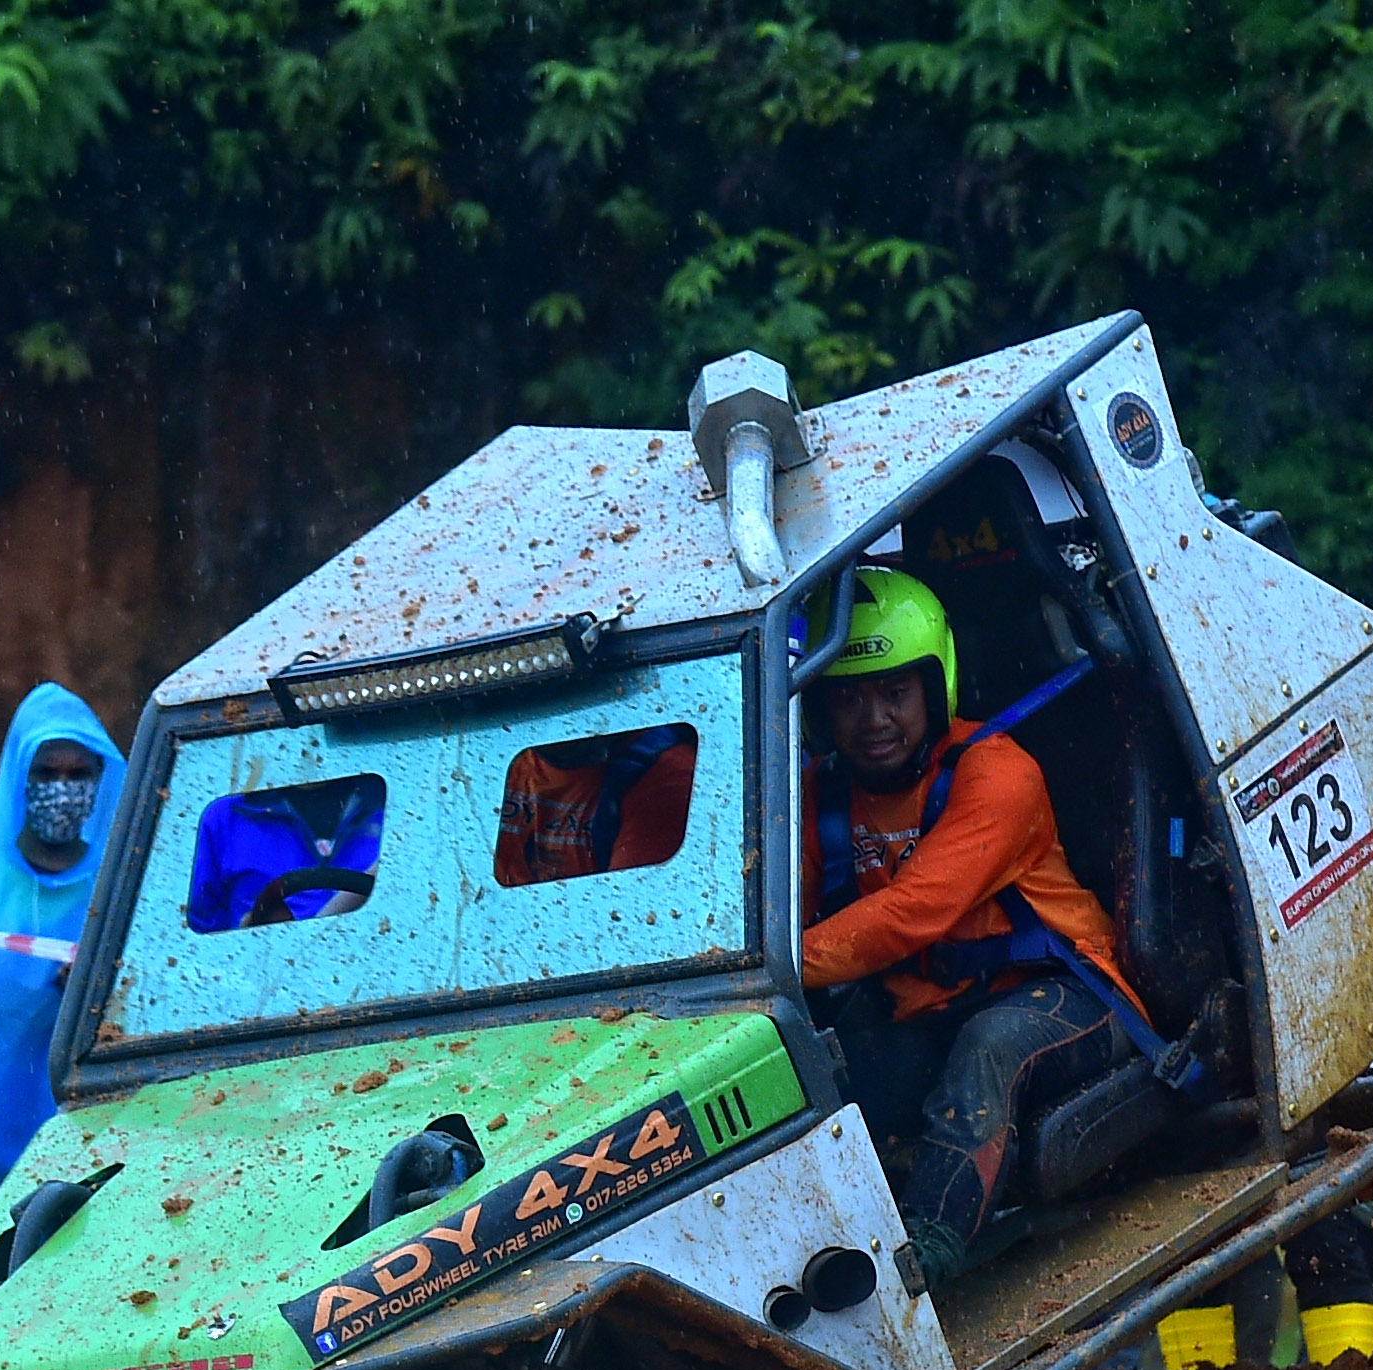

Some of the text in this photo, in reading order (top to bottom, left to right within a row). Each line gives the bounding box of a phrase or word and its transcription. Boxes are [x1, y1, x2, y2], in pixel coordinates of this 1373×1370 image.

[502, 799, 536, 825] DY
[1268, 773, 1353, 879] 123
[1312, 871, 1336, 897] OPEN
[313, 1110, 682, 1334] ADY 4X4
[341, 1145, 693, 1343] ADY FOURWHEEL TYRE RIM 017-226 5354
